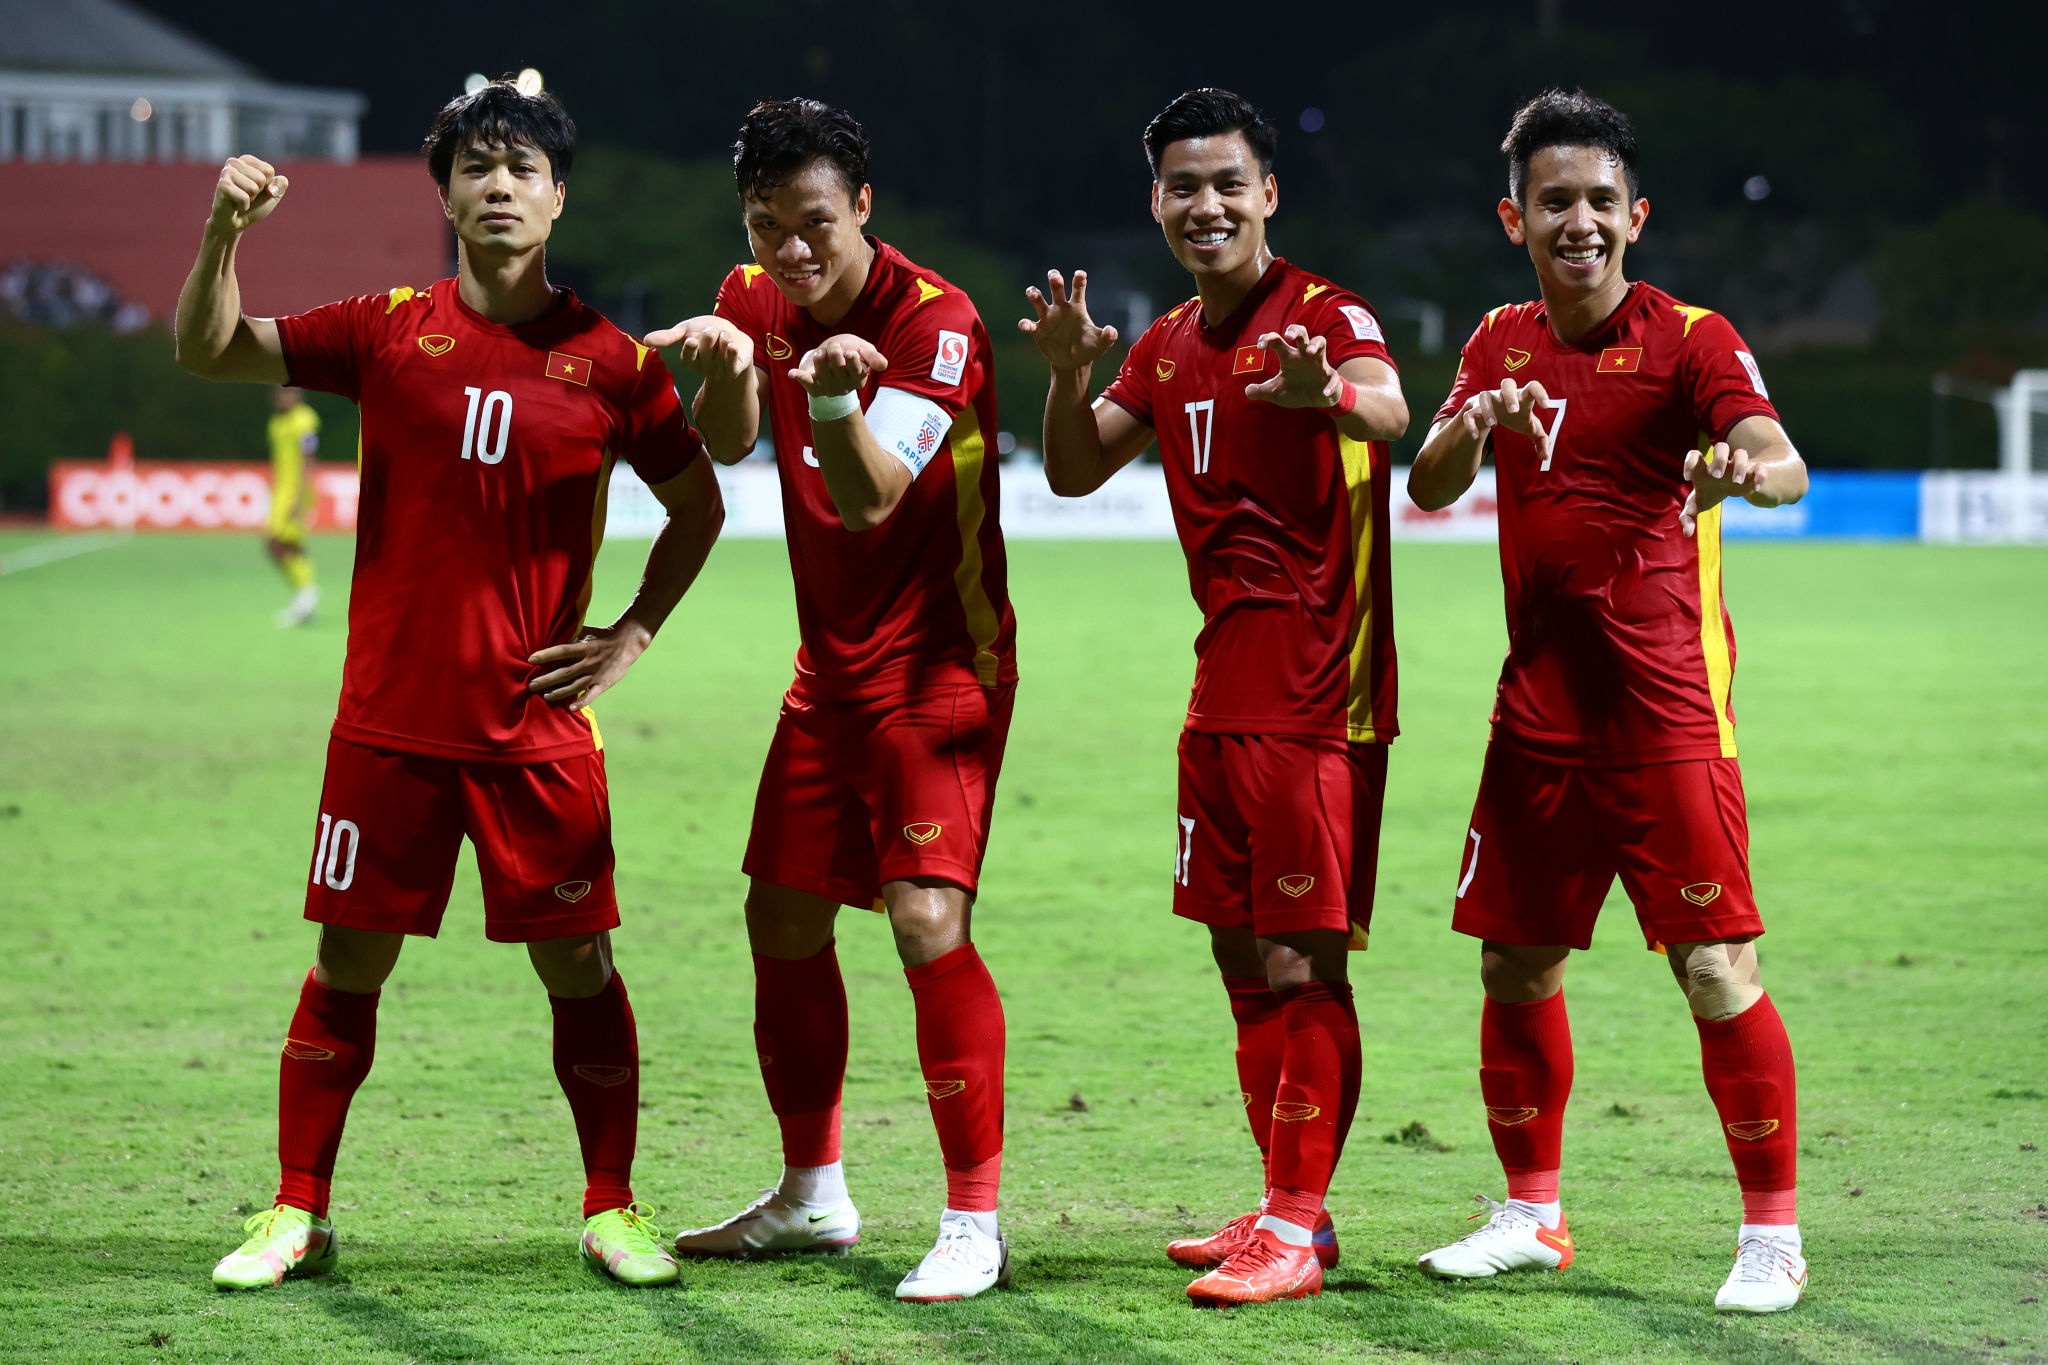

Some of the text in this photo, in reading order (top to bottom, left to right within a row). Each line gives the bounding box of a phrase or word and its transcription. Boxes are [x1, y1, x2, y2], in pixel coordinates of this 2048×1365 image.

[461, 386, 513, 465] 10
[1184, 399, 1215, 475] 17
[1540, 398, 1567, 472] 7
[313, 812, 360, 891] 10
[1456, 827, 1482, 899] 7
